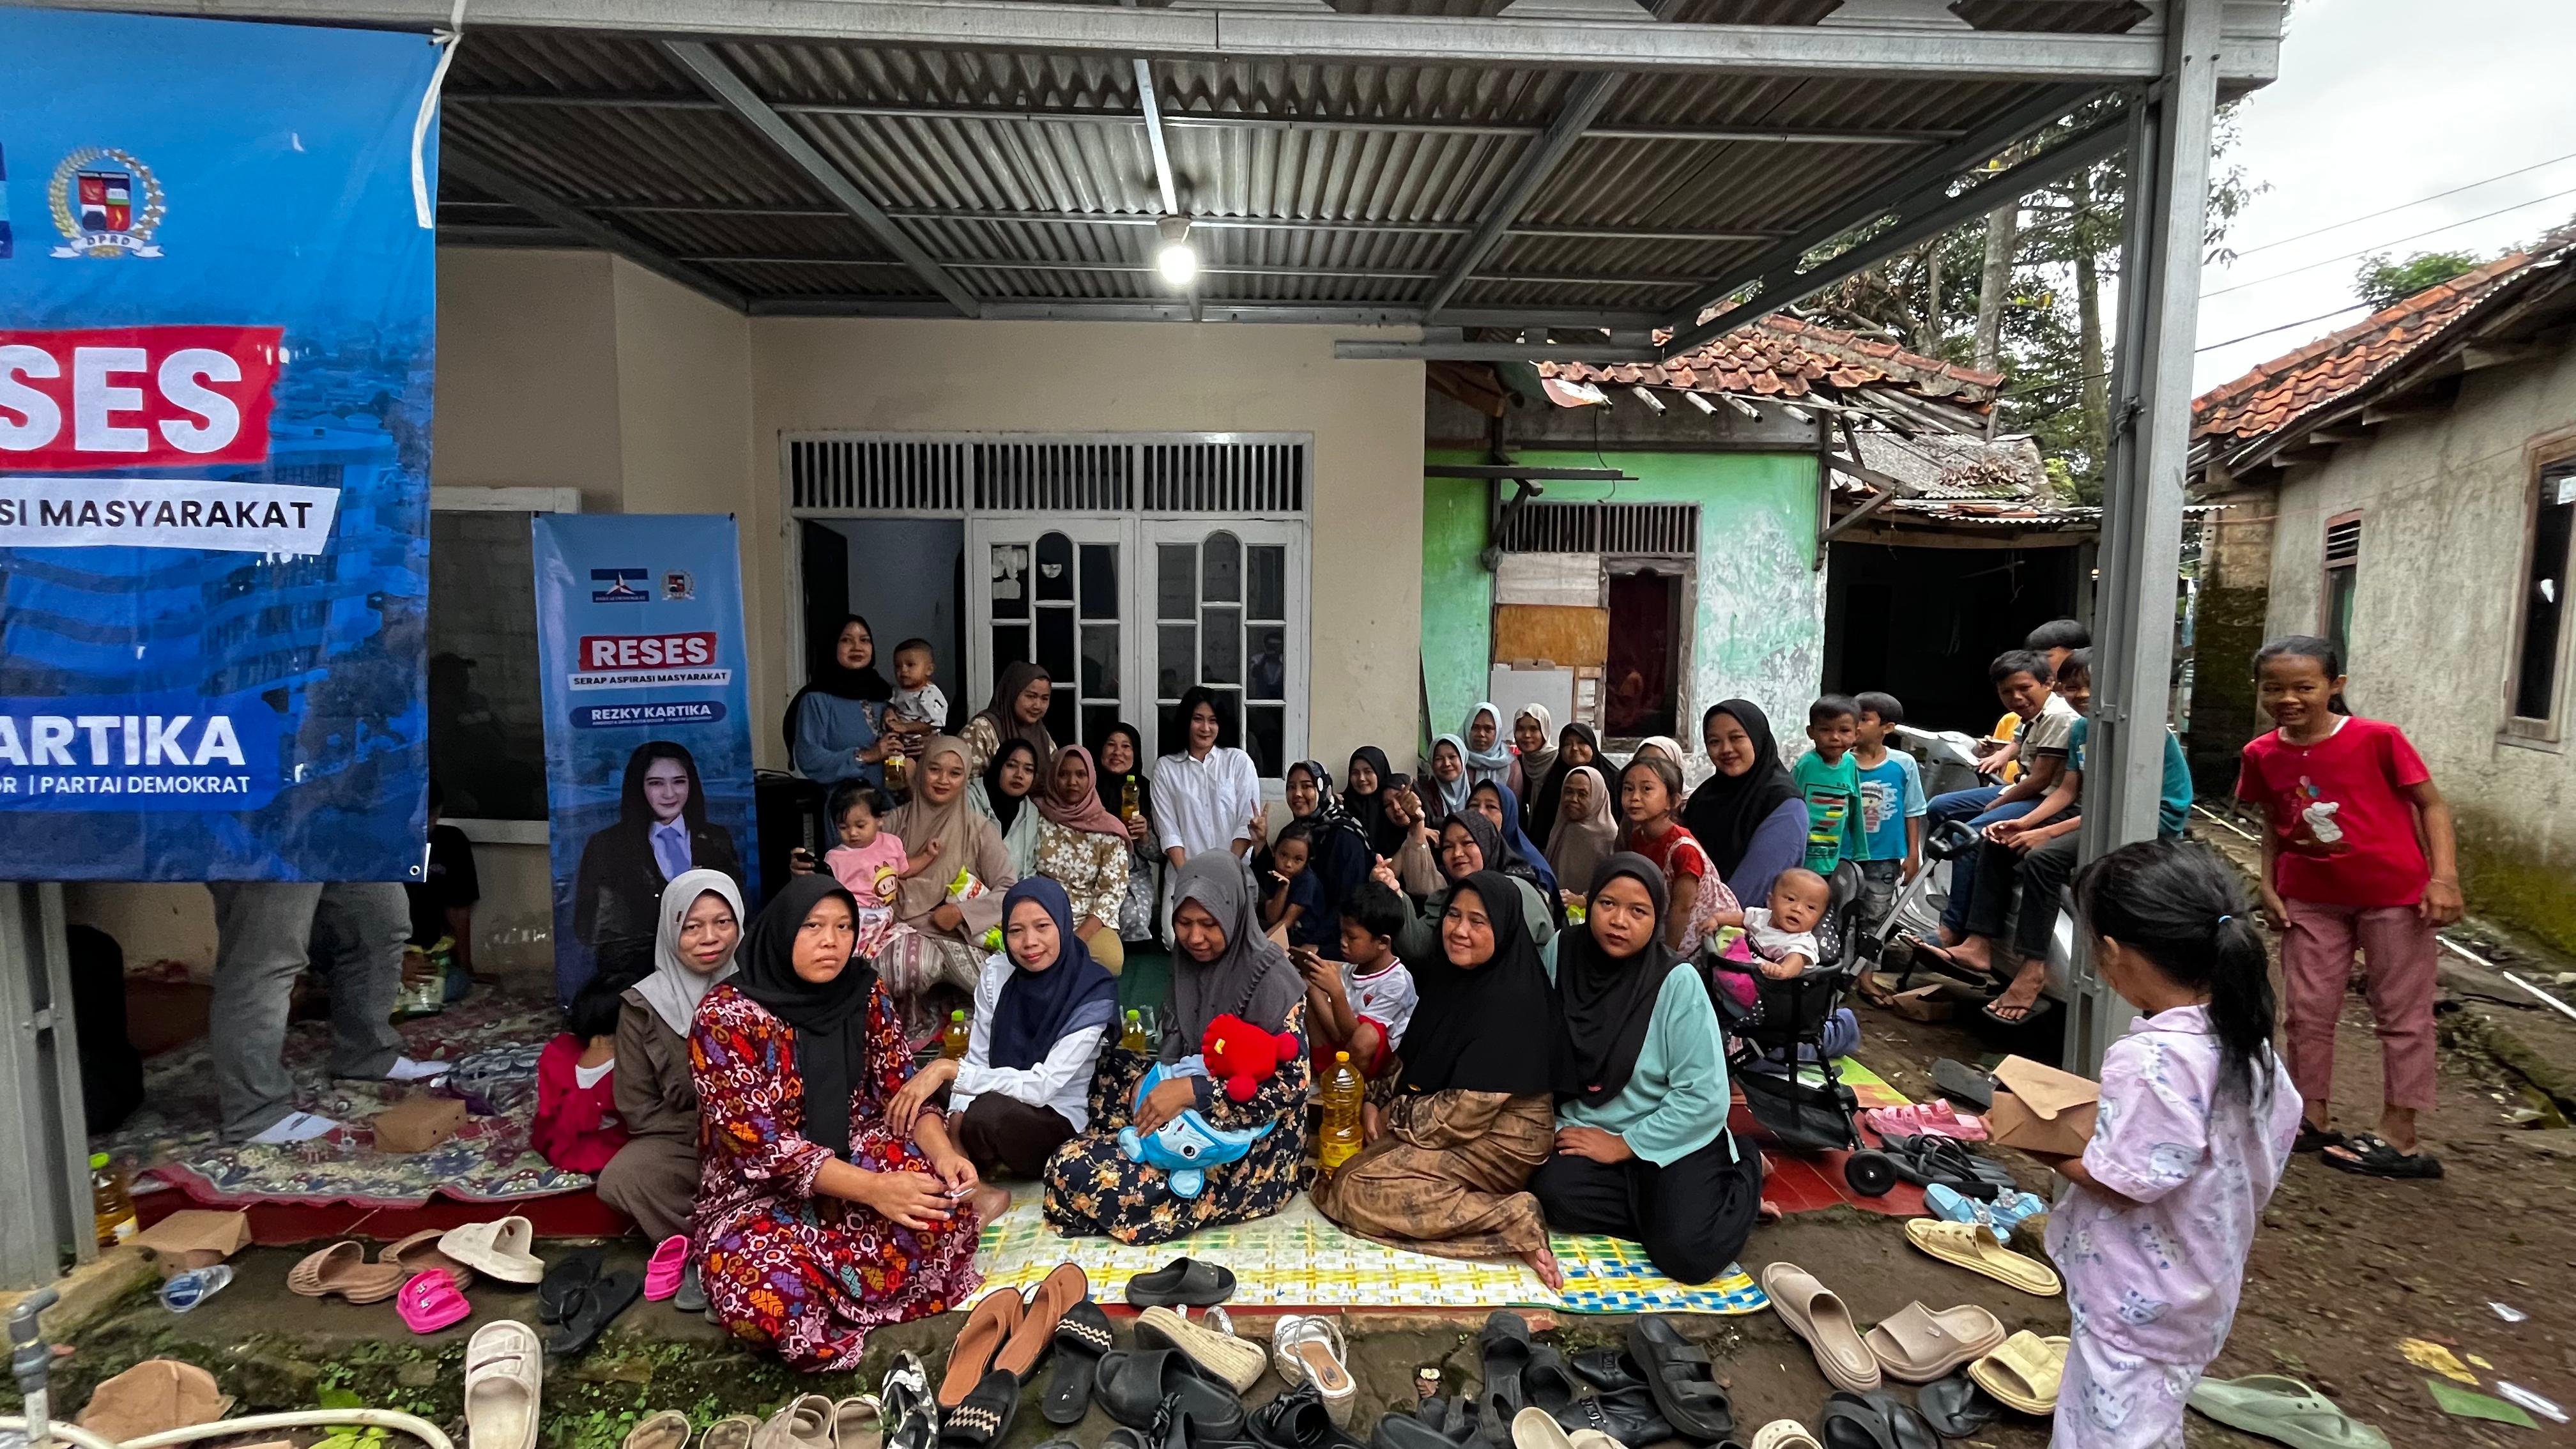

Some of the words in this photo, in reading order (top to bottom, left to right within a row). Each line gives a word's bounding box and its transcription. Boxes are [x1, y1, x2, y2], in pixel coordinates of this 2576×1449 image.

[87, 235, 130, 245] DPRD
[40, 500, 313, 530] MASYARAKAT
[592, 638, 708, 666] RESES
[610, 675, 656, 684] ASPIRASI
[657, 673, 727, 682] MASYARAKAT
[592, 707, 641, 720] REZKY
[645, 705, 711, 717] KARTIKA
[41, 776, 121, 793] PARTAI
[128, 776, 250, 793] DEMOKRAT
